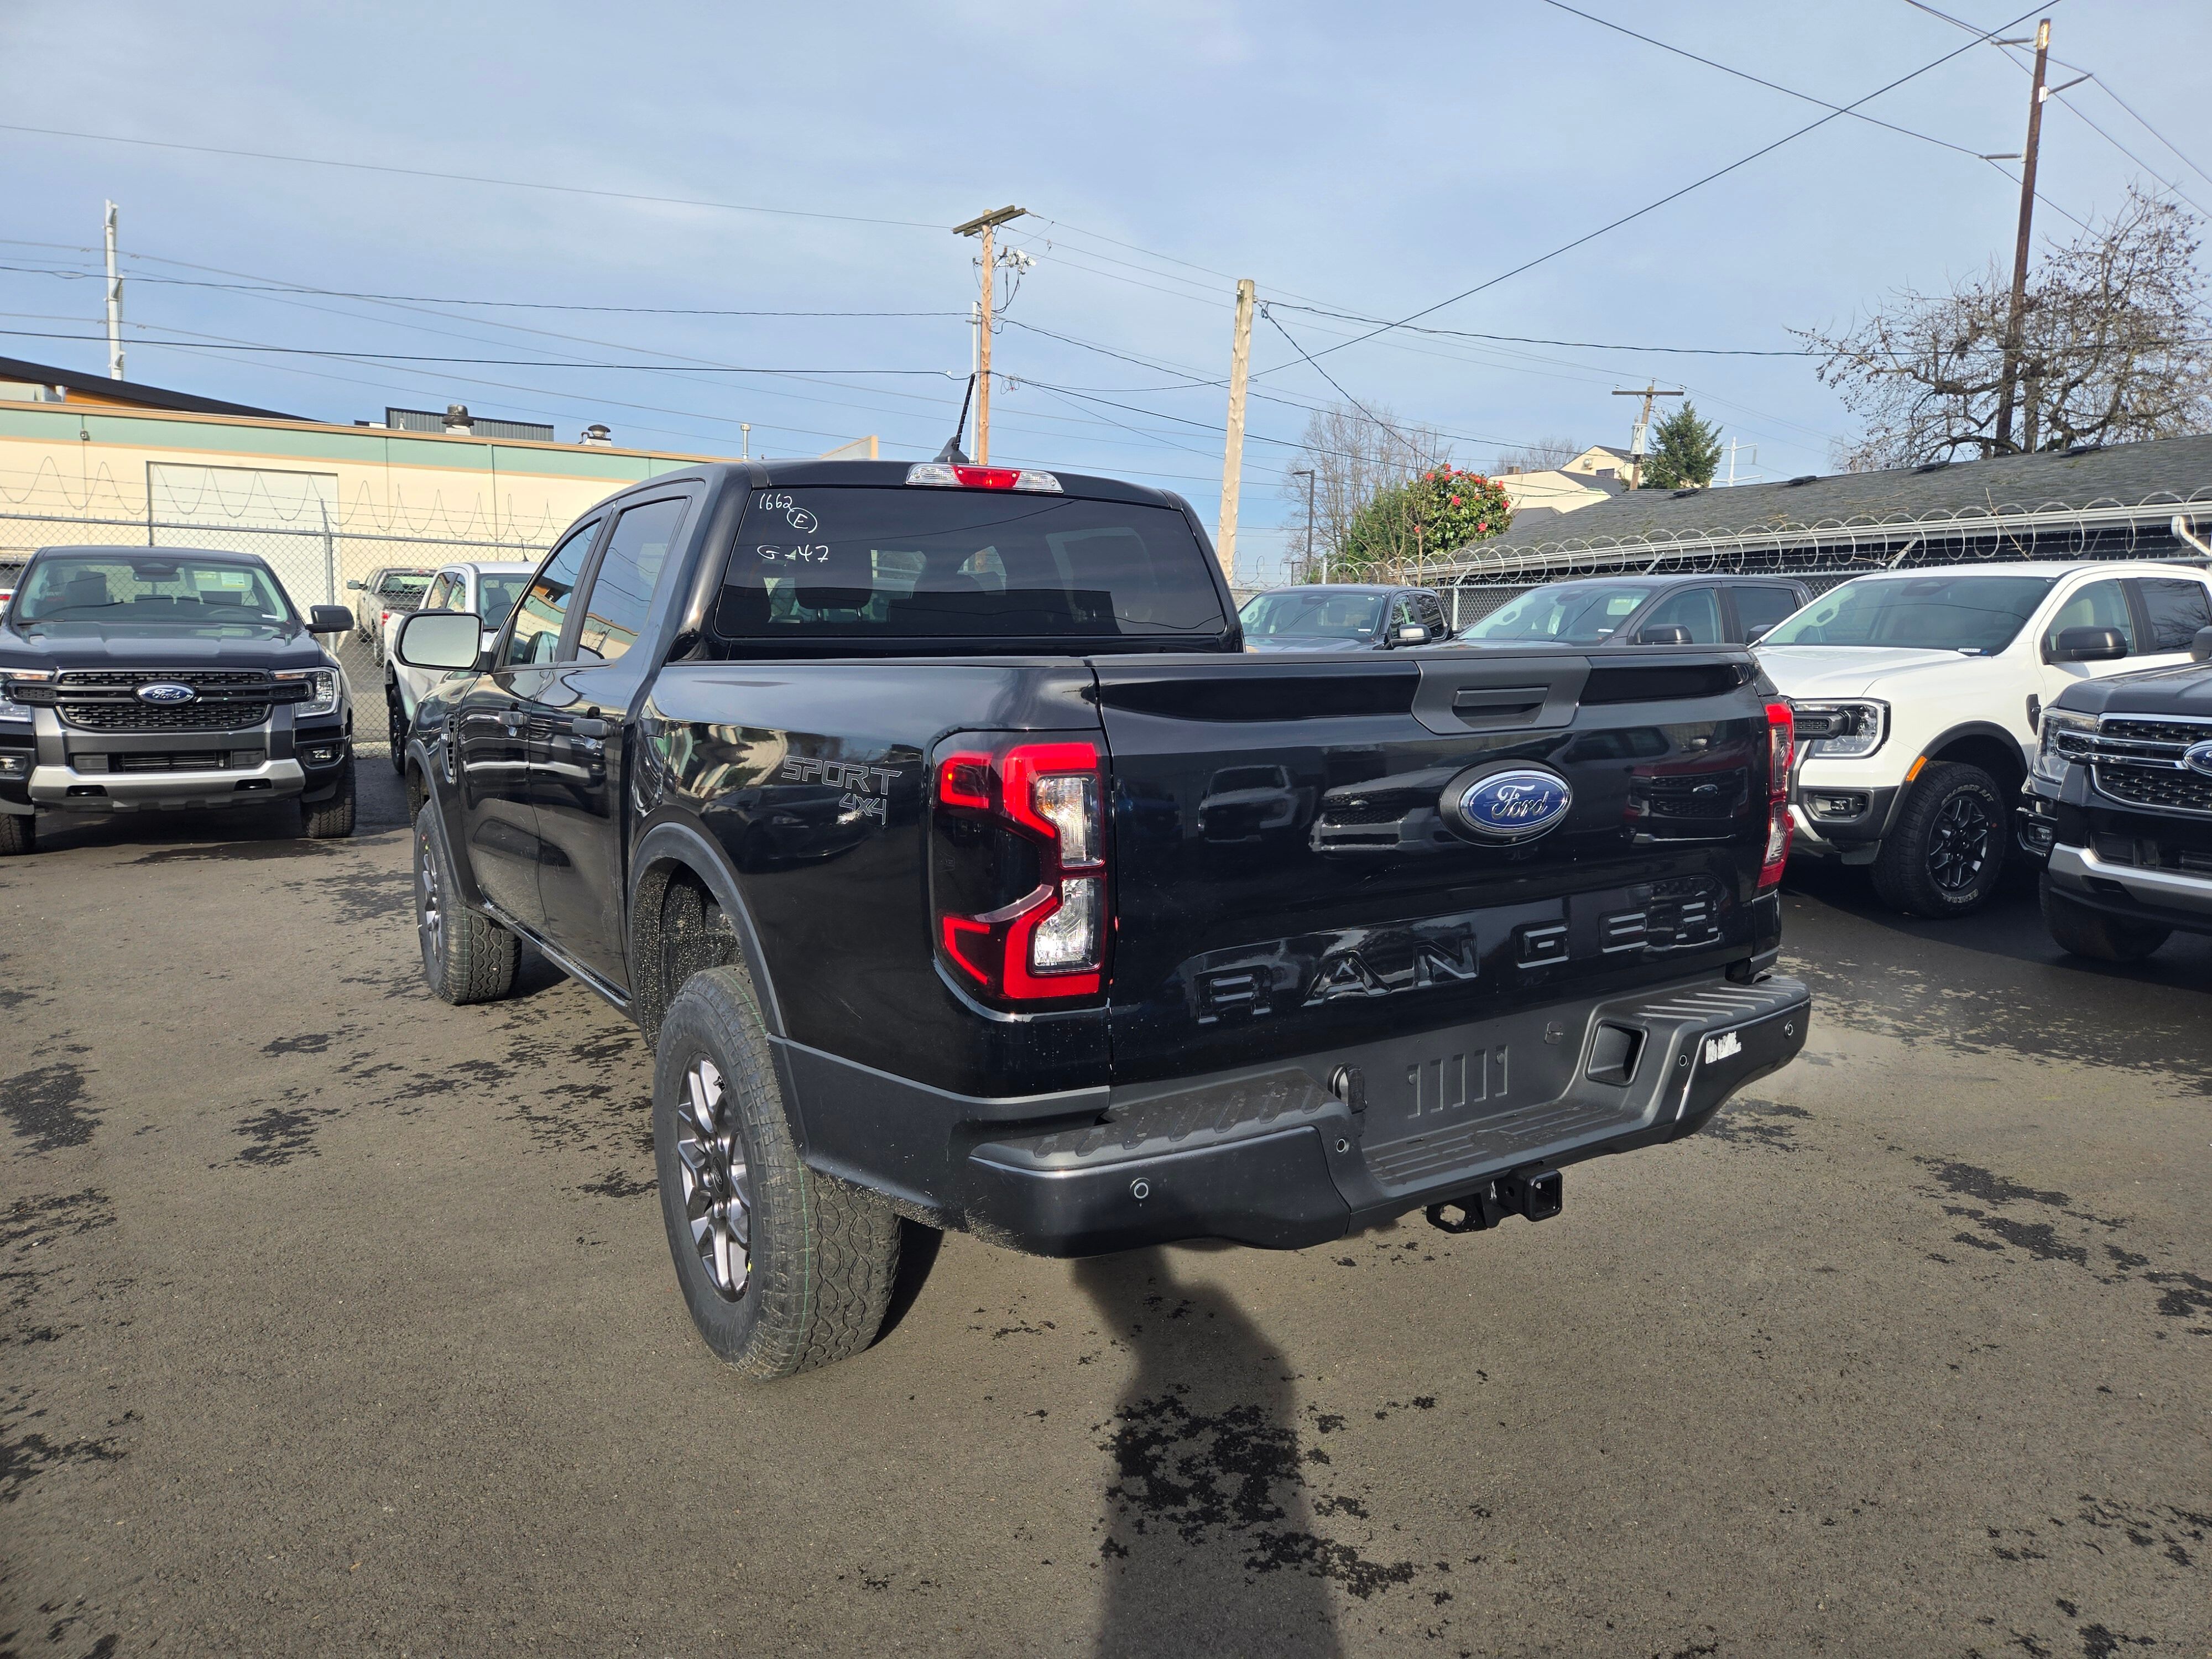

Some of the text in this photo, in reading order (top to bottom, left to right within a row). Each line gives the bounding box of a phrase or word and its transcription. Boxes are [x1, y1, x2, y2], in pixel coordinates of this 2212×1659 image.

[759, 493, 795, 512] 1662
[152, 688, 181, 699] Ford
[781, 755, 903, 795] SPORT
[1491, 784, 1550, 820] Ford
[1194, 889, 1719, 1024] RANGER
